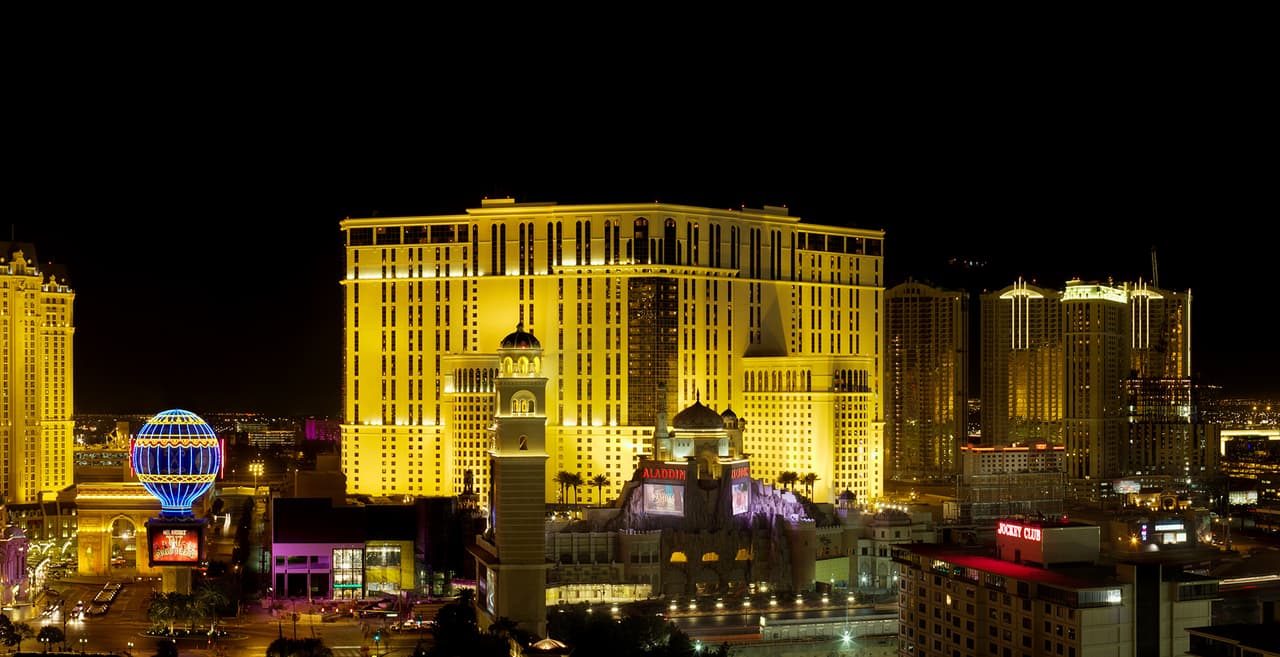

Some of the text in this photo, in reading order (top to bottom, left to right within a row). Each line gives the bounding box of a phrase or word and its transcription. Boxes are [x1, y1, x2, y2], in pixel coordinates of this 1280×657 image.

[643, 467, 685, 480] ALADDIN
[997, 522, 1041, 541] JOCKEY CLUB
